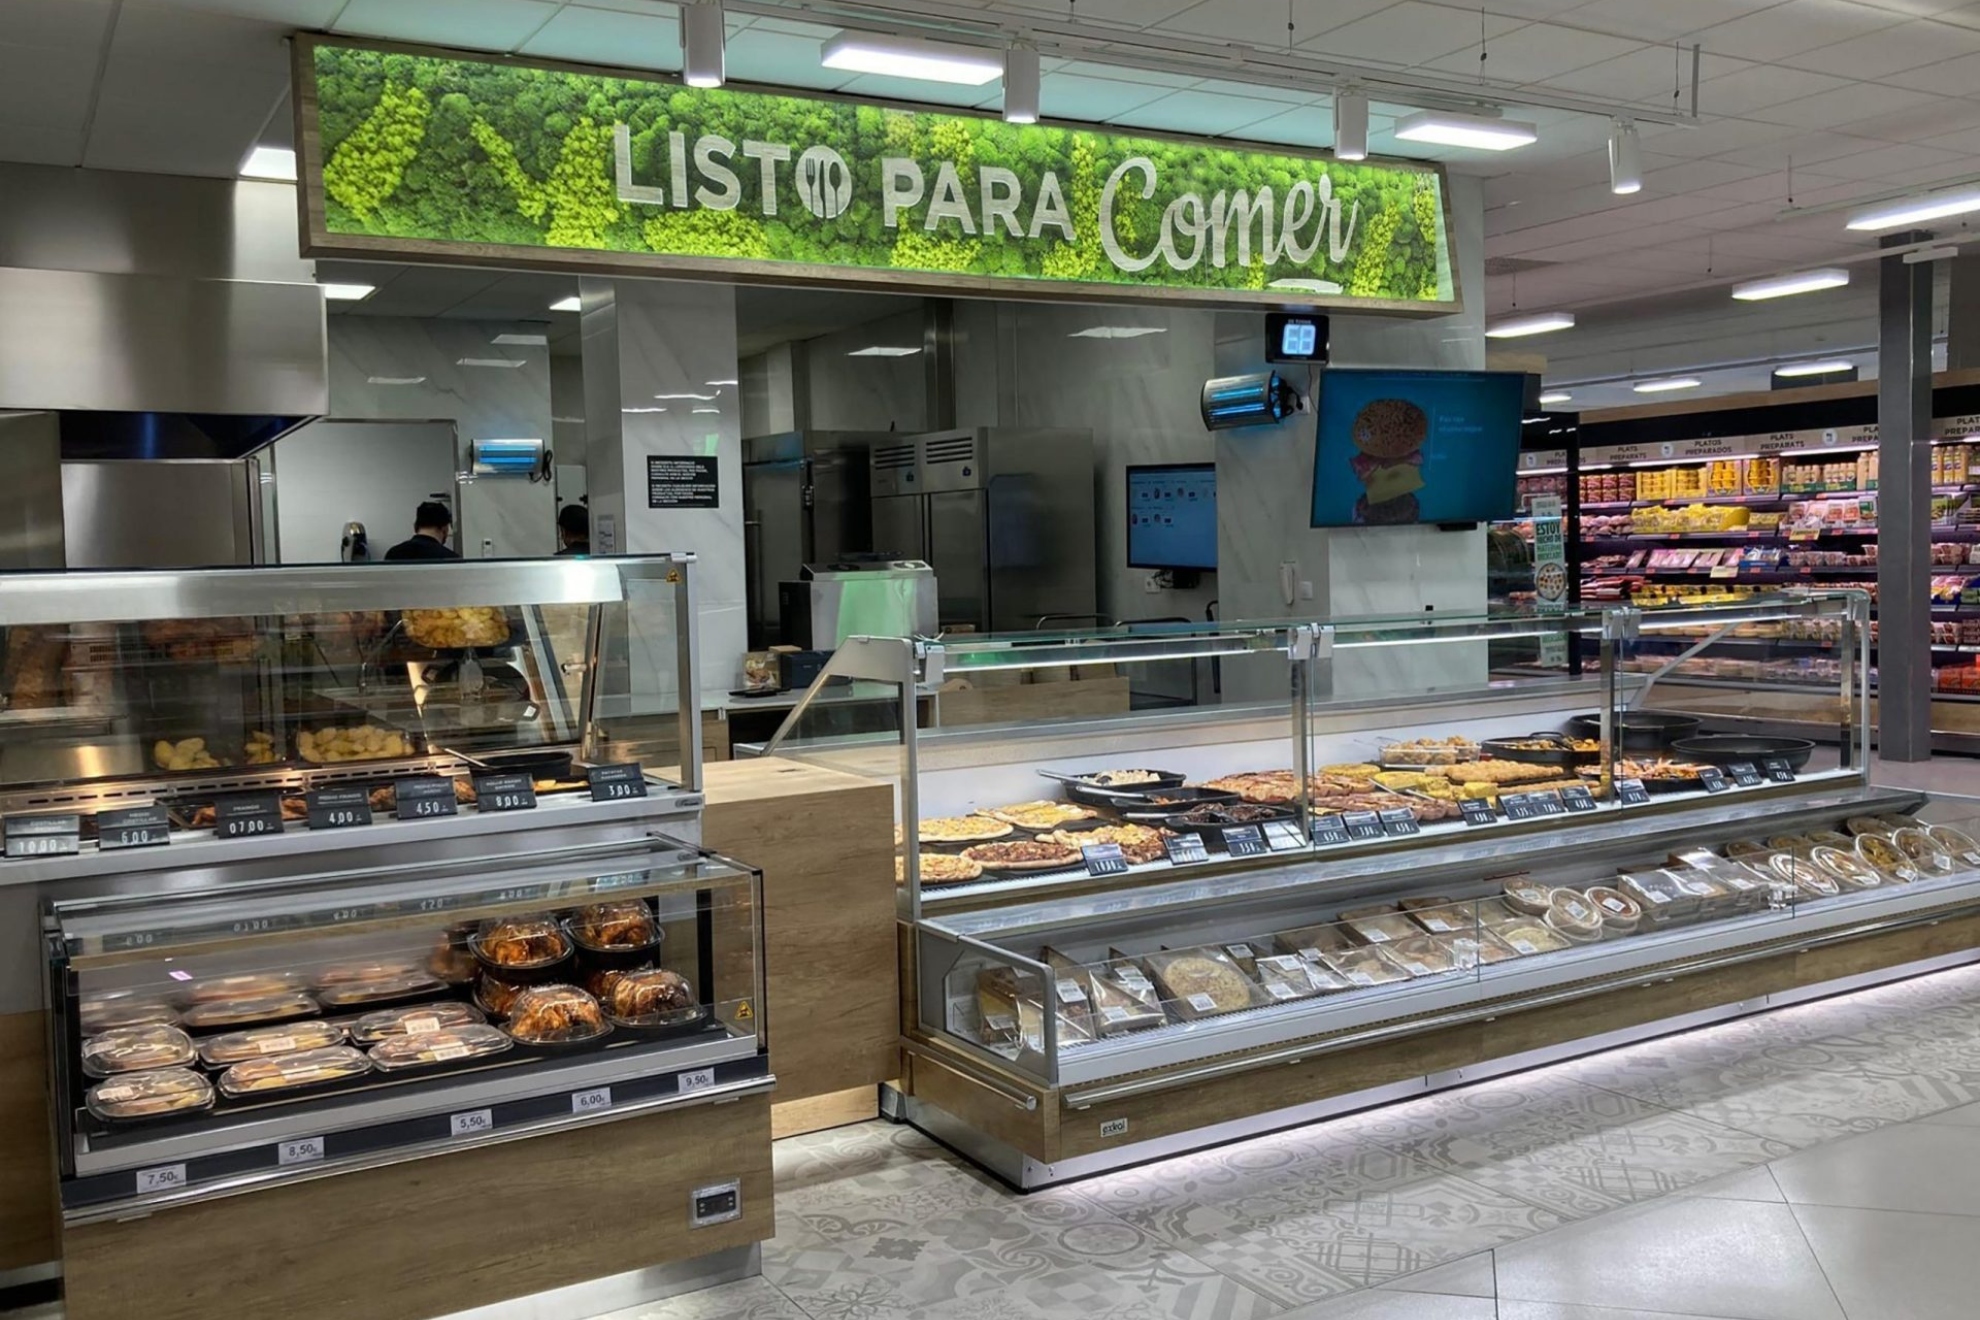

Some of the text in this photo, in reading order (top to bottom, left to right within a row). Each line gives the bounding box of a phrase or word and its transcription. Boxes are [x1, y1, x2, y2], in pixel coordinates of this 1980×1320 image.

[614, 124, 1358, 272] LISTO PARA Comer
[1685, 447, 1732, 455] PREPARADOS
[1760, 441, 1805, 450] PREPARATS
[1536, 522, 1560, 535] ESTOY
[416, 801, 440, 815] 4,50
[329, 811, 353, 825] 4,00
